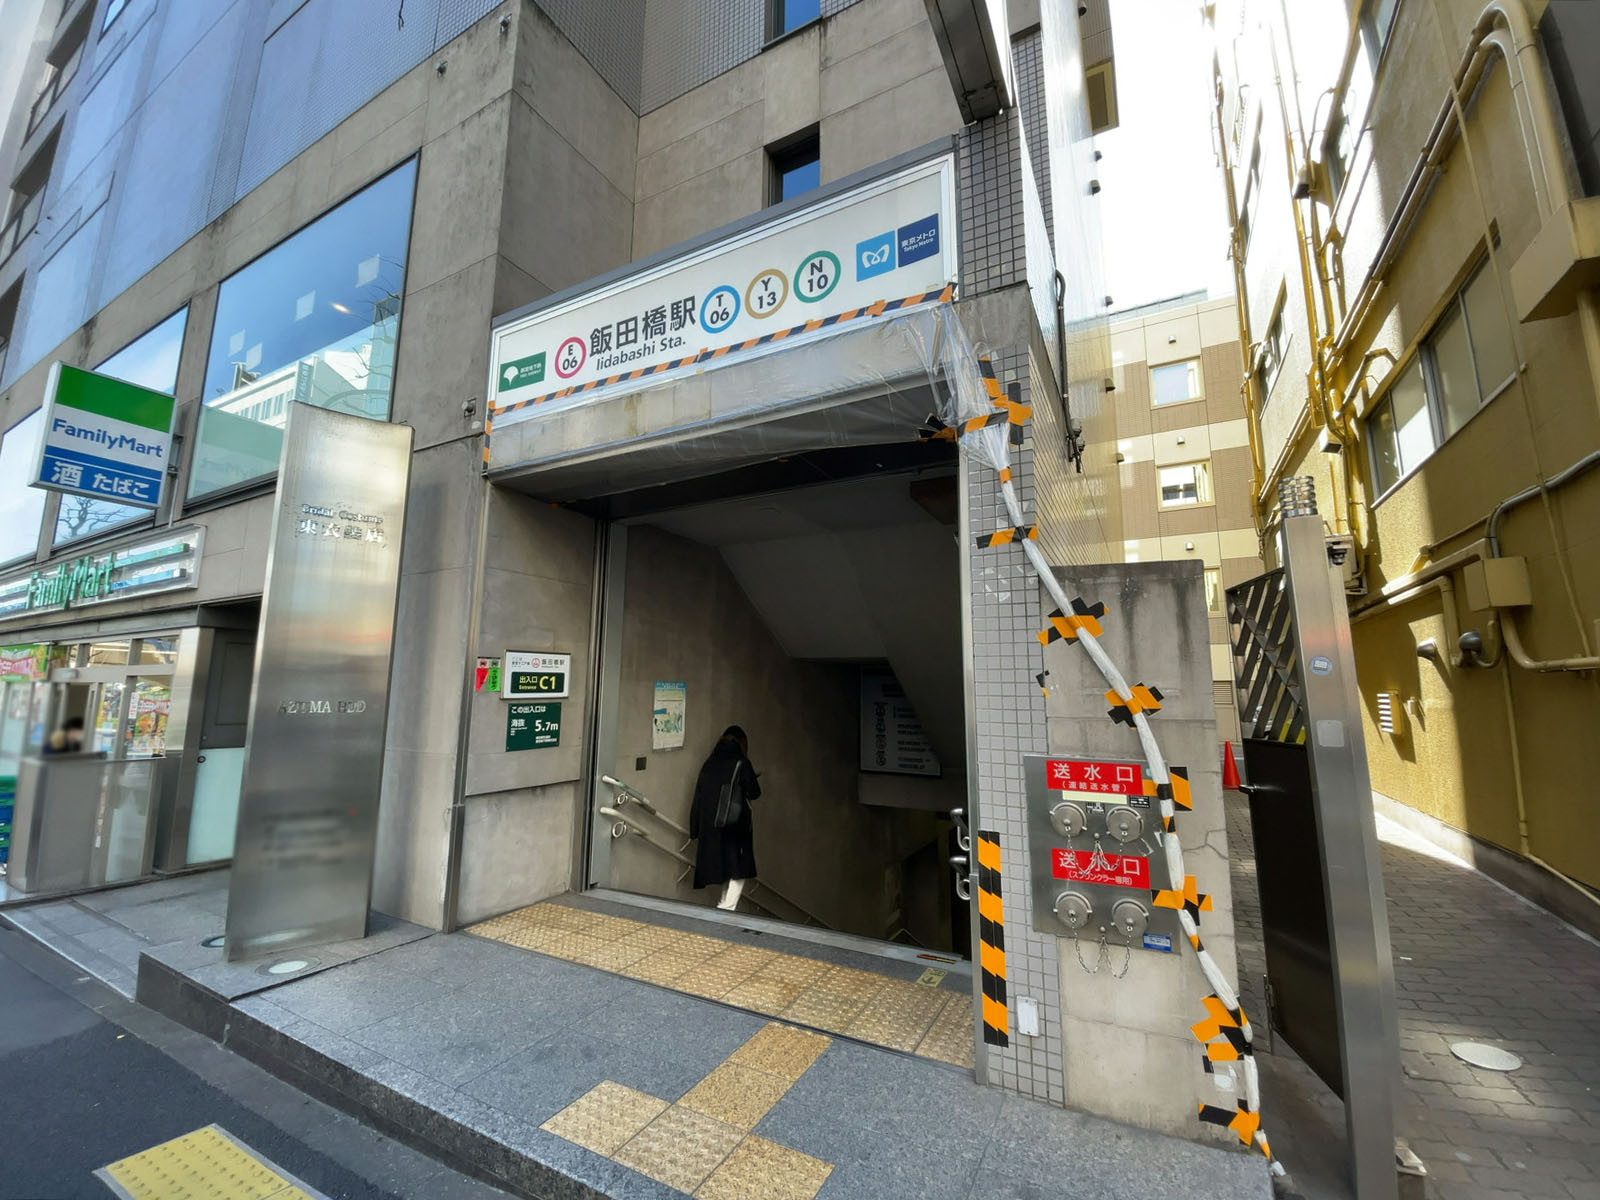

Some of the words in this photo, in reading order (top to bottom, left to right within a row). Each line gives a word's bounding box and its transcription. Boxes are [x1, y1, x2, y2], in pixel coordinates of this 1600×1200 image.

[901, 229, 936, 247] 東京メトロ
[903, 244, 918, 252] Tokyo
[918, 237, 934, 247] Metro
[810, 259, 823, 276] N
[760, 277, 772, 292] Y
[806, 274, 829, 293] 10
[715, 294, 724, 308] T
[757, 291, 777, 310] 13
[710, 307, 730, 325] 06
[589, 296, 696, 358] 飯田橋駅
[567, 344, 574, 356] E
[596, 340, 656, 371] Iidabashi
[660, 336, 686, 353] Sta.
[562, 357, 578, 371] 06
[52, 417, 163, 458] FamilyMart
[51, 461, 84, 488] 酒
[91, 472, 149, 499] たばこ
[301, 503, 334, 518] Bridal
[26, 552, 116, 610] FamilyMart
[519, 676, 538, 684] 出入口
[539, 676, 556, 690] C1
[511, 705, 546, 714] この出入口は
[534, 719, 559, 732] 5.7m
[1053, 763, 1134, 783] 送水口
[1058, 851, 1140, 876] 送水口
